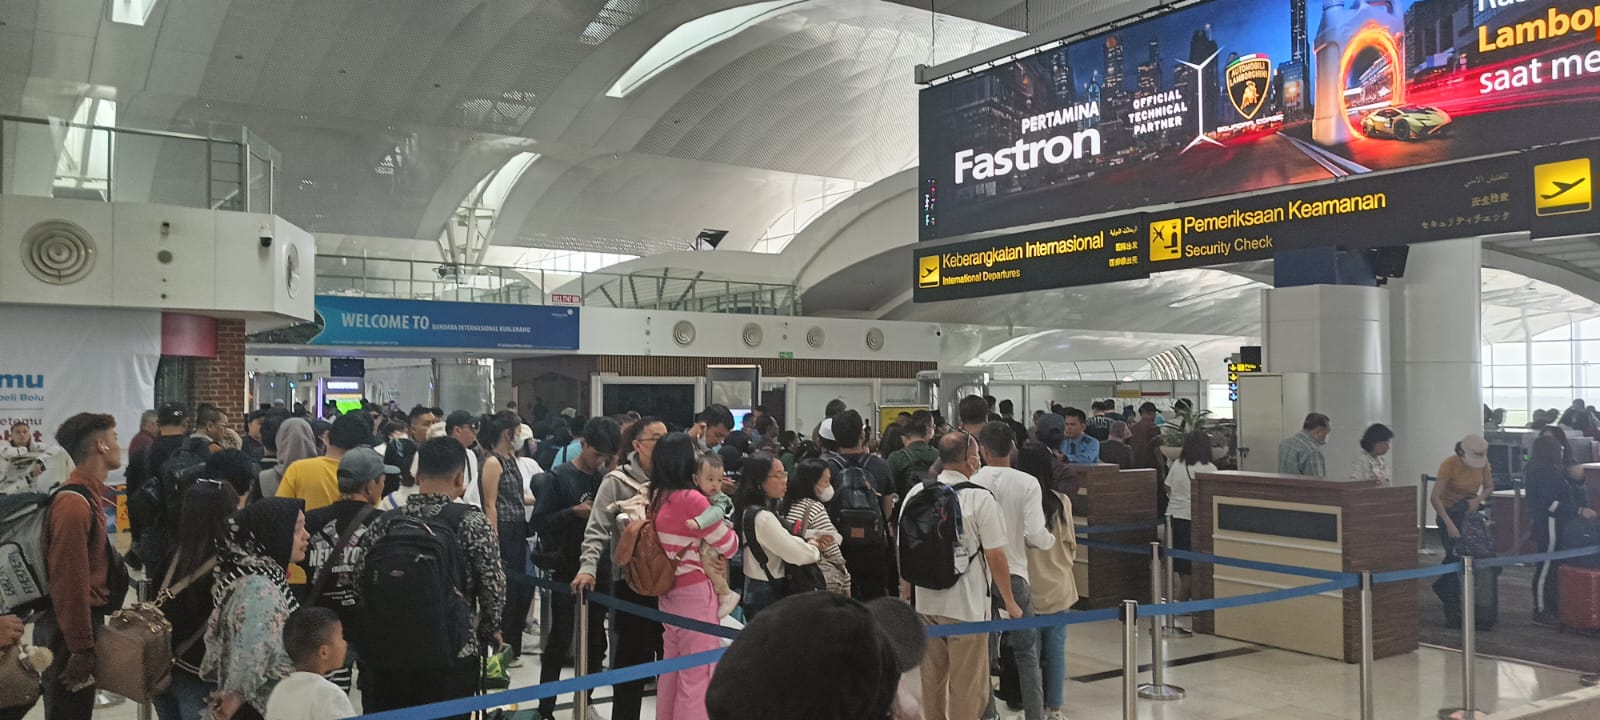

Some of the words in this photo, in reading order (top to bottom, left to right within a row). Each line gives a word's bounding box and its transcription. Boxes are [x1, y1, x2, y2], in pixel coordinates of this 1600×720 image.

[1231, 61, 1266, 77] AUTOMOBILI
[1480, 58, 1542, 94] saat
[1132, 89, 1182, 110] OFFICIAL
[1021, 100, 1100, 135] PERTAMINA
[1127, 102, 1188, 124] TECHNICAL
[1133, 116, 1183, 136] PARTNER
[954, 127, 1101, 185] Fastron
[1184, 207, 1285, 235] Pemeriksaan
[1288, 192, 1387, 221] Keamanan
[942, 245, 1023, 269] Keberangkatan
[1025, 230, 1104, 258] Internasional
[1185, 240, 1231, 258] Security
[1233, 234, 1273, 252] Check
[942, 274, 982, 286] International
[982, 268, 1021, 282] Departures
[341, 312, 409, 330] WELCOME
[411, 315, 430, 330] TO
